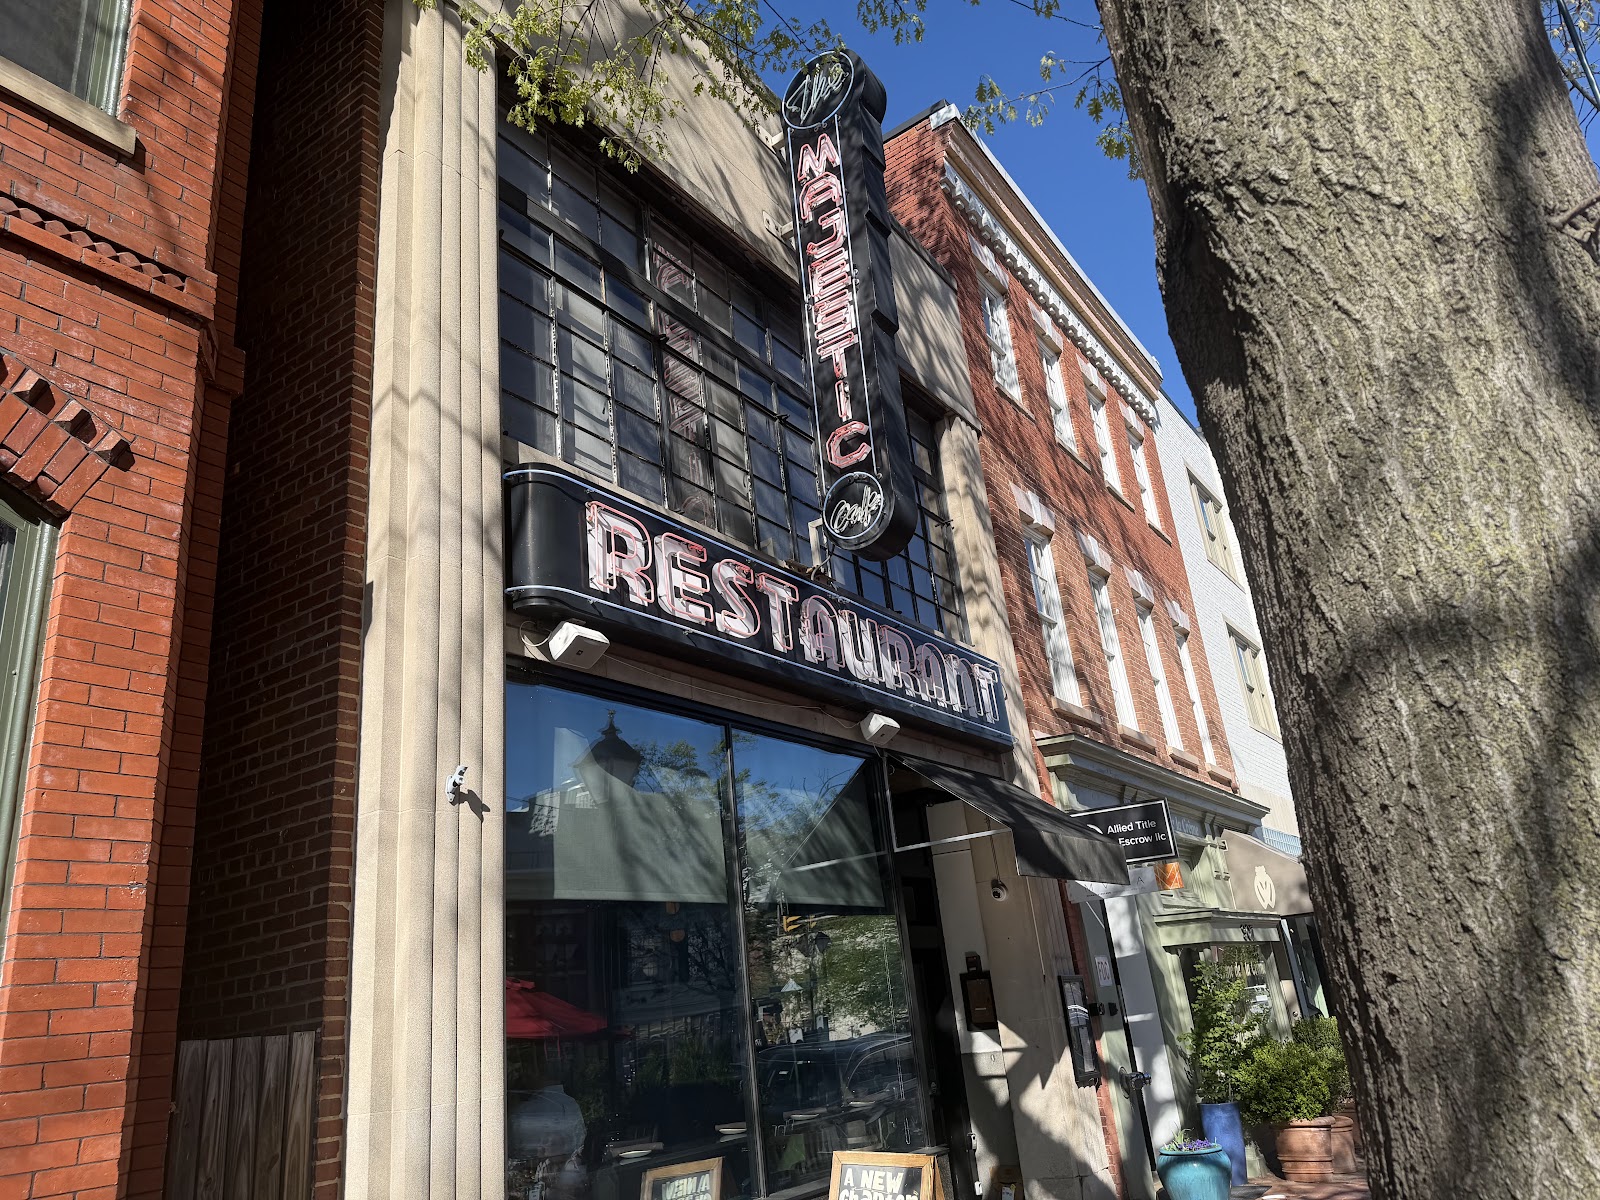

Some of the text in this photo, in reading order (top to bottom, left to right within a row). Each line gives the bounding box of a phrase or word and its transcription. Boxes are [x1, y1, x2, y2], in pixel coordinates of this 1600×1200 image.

[798, 133, 872, 468] MAJESTIC
[584, 500, 1000, 725] RESTAURANT
[1107, 822, 1134, 834] Allied
[1135, 820, 1157, 830] Title
[1119, 834, 1153, 846] Escrow
[843, 1168, 904, 1193] A NEW
